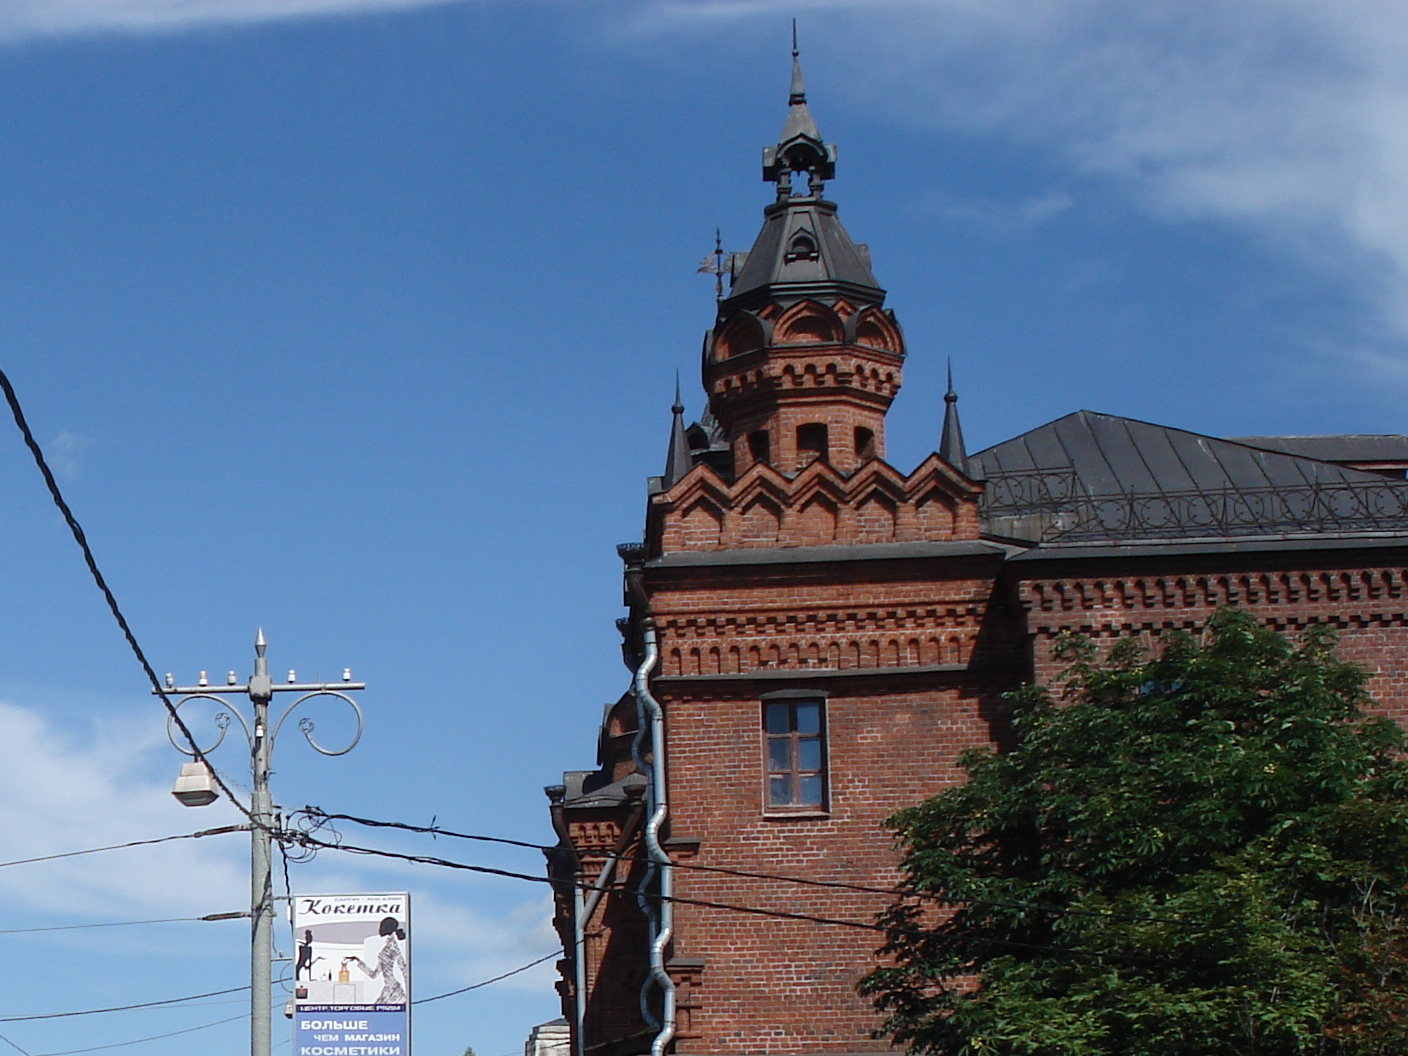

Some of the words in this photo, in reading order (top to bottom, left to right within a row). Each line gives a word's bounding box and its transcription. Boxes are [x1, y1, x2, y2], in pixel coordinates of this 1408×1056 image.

[298, 899, 401, 915] Кокетка
[300, 1020, 368, 1030] БОЛЬШЕ
[313, 1034, 339, 1042] ЧЕМ
[344, 1034, 401, 1042] МАГАЗИН
[301, 1046, 401, 1056] КОСМЕТИКИ
